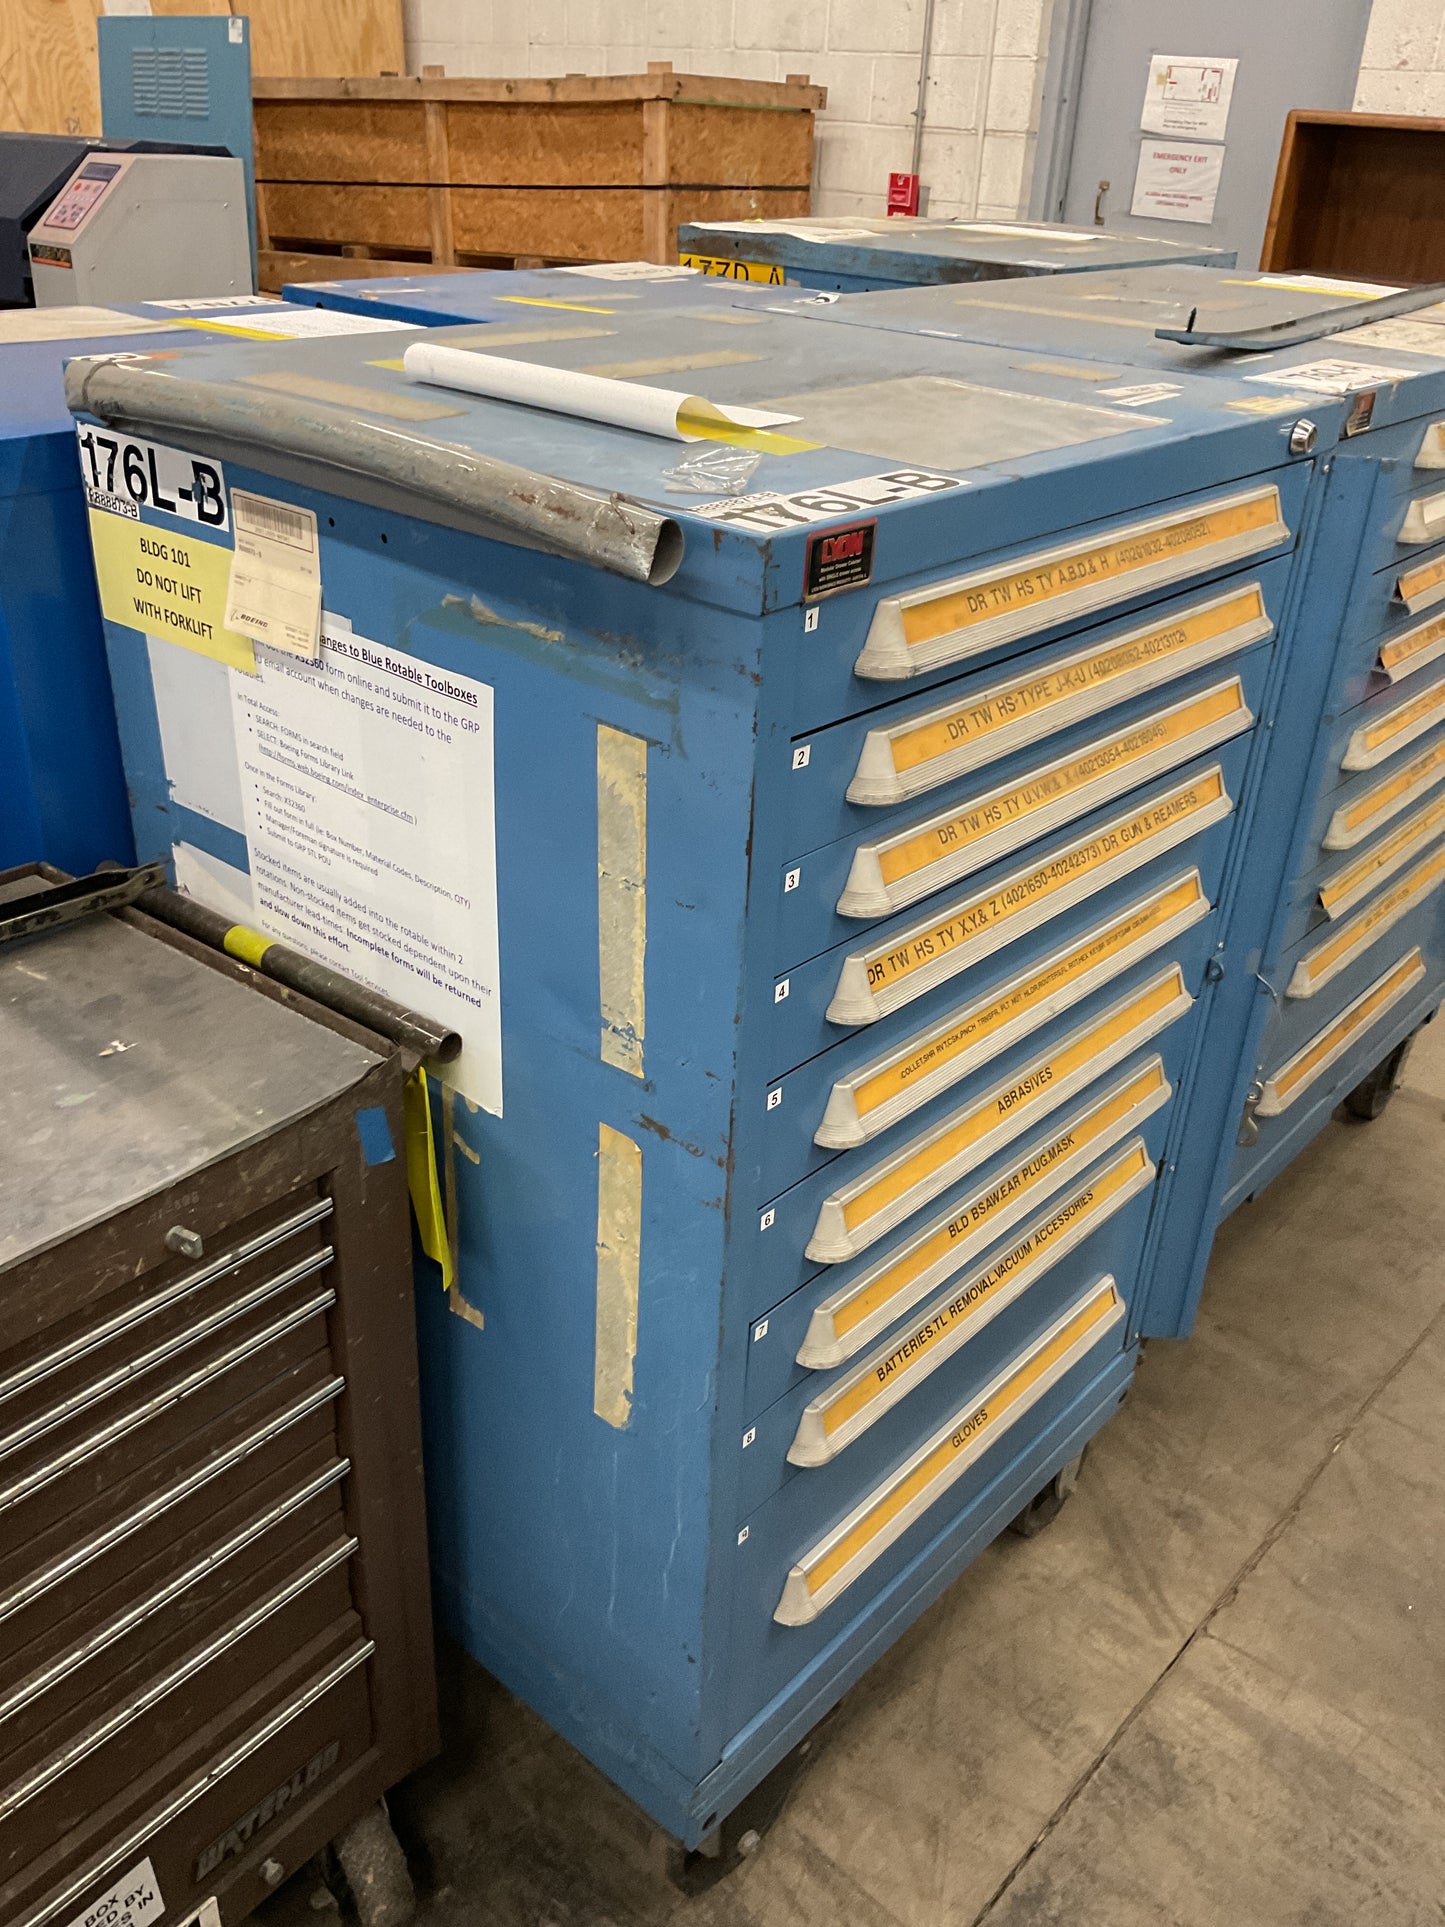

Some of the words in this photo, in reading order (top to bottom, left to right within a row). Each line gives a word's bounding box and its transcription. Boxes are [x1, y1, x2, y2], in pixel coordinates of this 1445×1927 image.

[81, 431, 224, 526] 176L-B
[713, 471, 961, 528] 176L-B
[140, 537, 168, 561] BLDG
[171, 548, 191, 568] 101
[821, 531, 865, 564] LYON
[136, 568, 153, 587] DO
[155, 574, 178, 596] NOT
[180, 583, 202, 605] LIFT
[966, 591, 988, 614] DR
[989, 584, 1011, 606] TW
[1016, 577, 1034, 598] HS
[1036, 571, 1052, 591] TY
[133, 597, 162, 621] WITH
[164, 608, 213, 640] FORKLIFT
[240, 613, 268, 628] BOEING
[805, 613, 814, 628] 1
[349, 643, 359, 659] to
[361, 648, 383, 668] Blue
[385, 657, 422, 684] Rotable
[425, 673, 477, 706] Toolboxes
[263, 656, 284, 675] email
[285, 665, 315, 688] account
[317, 678, 339, 698] when
[341, 689, 374, 714] changes
[376, 703, 389, 719] are
[391, 709, 423, 733] needed
[425, 723, 434, 738] to
[437, 728, 451, 745] the
[325, 661, 345, 680] form
[347, 670, 372, 691] online
[374, 682, 389, 699] and
[392, 689, 421, 712] submit
[423, 701, 429, 715] it
[431, 705, 441, 720] to
[443, 710, 458, 727] the
[460, 717, 480, 736] GRP
[947, 716, 969, 741] DR
[969, 705, 992, 730] TW
[795, 750, 804, 765] 2
[937, 822, 957, 846] DR
[959, 812, 980, 837] TW
[984, 802, 1002, 825] HS
[1003, 794, 1020, 816] TY
[788, 874, 795, 888] 3
[869, 961, 885, 984] DR
[888, 948, 909, 975] TW
[914, 935, 934, 961] HS
[936, 923, 956, 949] TY
[989, 898, 1000, 918] Z
[1103, 831, 1118, 853] DR
[1120, 819, 1142, 844] GUN
[1143, 814, 1152, 832] &
[1153, 789, 1197, 826] REAMERS
[254, 847, 280, 870] Stocked
[303, 871, 315, 887] are
[316, 880, 342, 903] usually
[343, 891, 366, 913] added
[368, 904, 384, 922] into
[385, 913, 398, 930] the
[400, 924, 429, 947] rotable
[430, 939, 456, 962] within
[458, 954, 462, 965] 2
[259, 896, 272, 911] and
[274, 903, 289, 920] slow
[291, 912, 311, 932] down
[312, 924, 326, 940] this
[346, 928, 389, 960] Incomplete
[391, 952, 414, 973] forms
[416, 965, 430, 982] will
[432, 973, 442, 988] be
[445, 980, 481, 1009] returned
[358, 919, 370, 934] get
[372, 924, 401, 948] stocked
[403, 942, 446, 974] dependent
[448, 967, 469, 986] upon
[471, 978, 491, 997] their
[777, 984, 786, 998] 4
[770, 1091, 779, 1106] 5
[997, 1064, 1052, 1115] ABRASIVES
[764, 1213, 772, 1227] 6
[948, 1212, 969, 1240] BLD
[1034, 1187, 1093, 1247] ACCESSORIES
[757, 1324, 766, 1339] 7
[746, 1431, 754, 1445] 8
[951, 1406, 987, 1451] GLOVES
[124, 1884, 144, 1908] BY
[138, 1891, 154, 1910] IN
